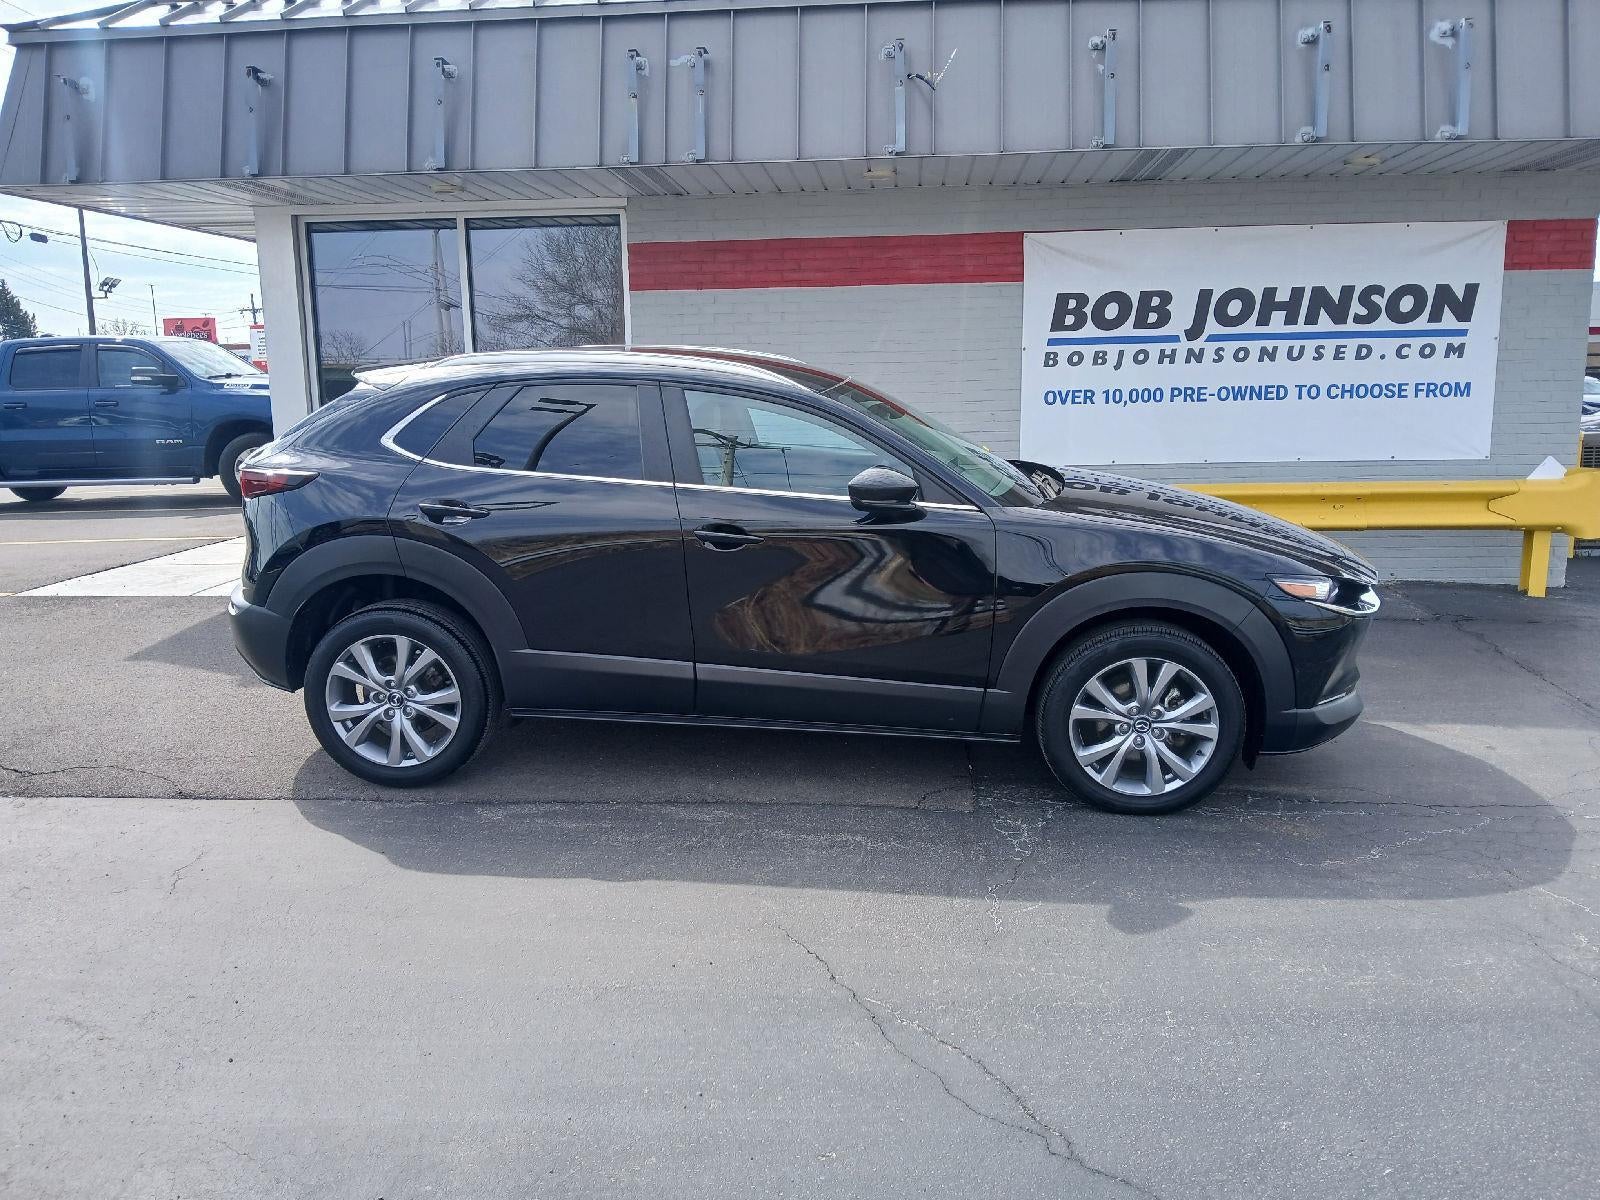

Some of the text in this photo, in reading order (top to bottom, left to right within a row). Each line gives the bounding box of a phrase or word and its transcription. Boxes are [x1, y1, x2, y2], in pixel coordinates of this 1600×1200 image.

[1049, 283, 1481, 342] BOB JOHNSON
[1043, 342, 1467, 371] BOBJOHNSONUSED.COM
[1043, 381, 1472, 408] OVER 10,000 PRE-OWNED TO CHOOSE FROM
